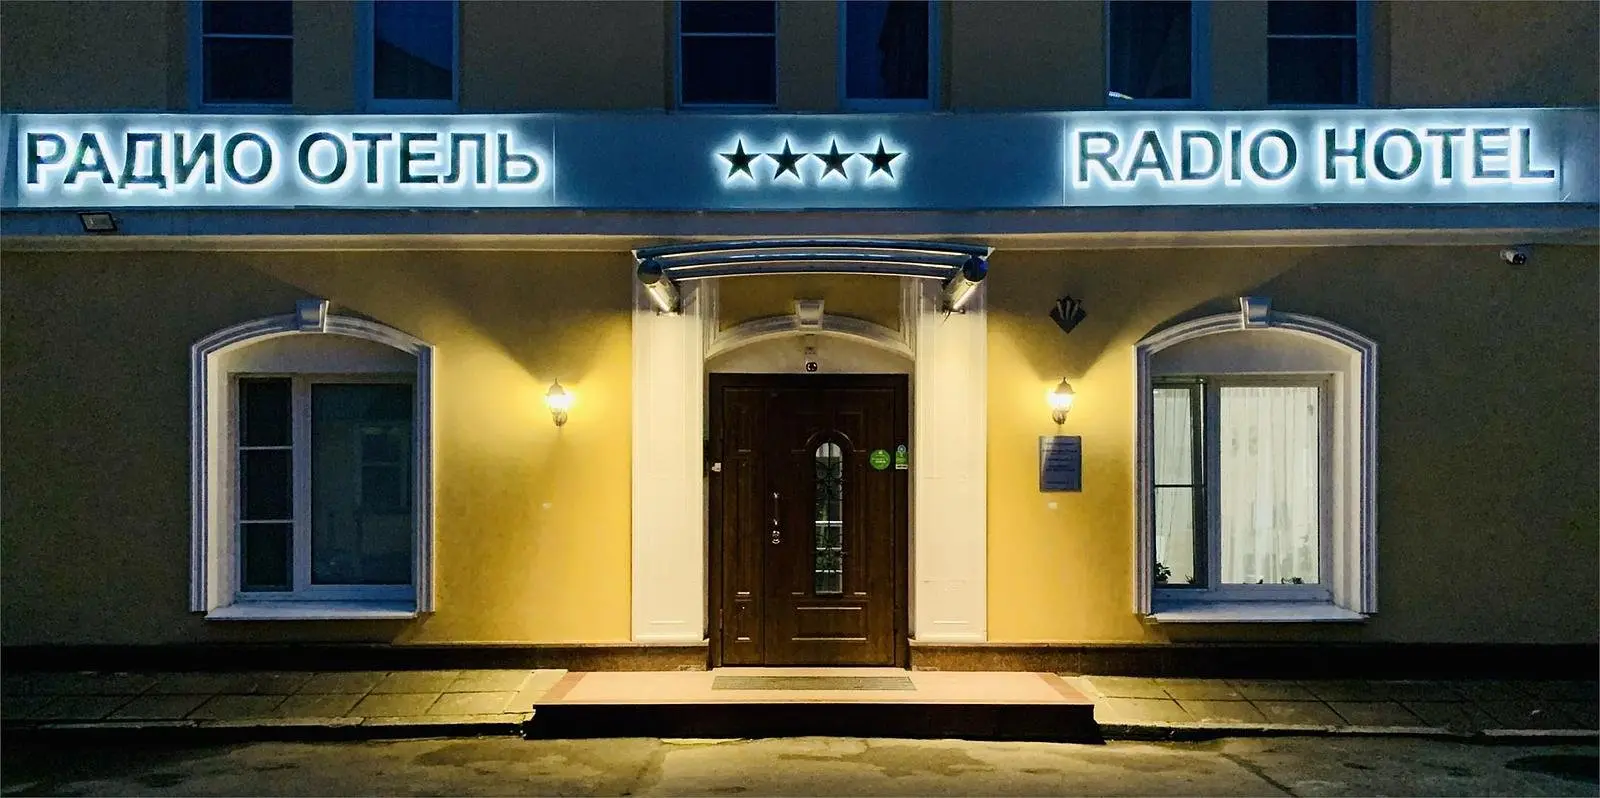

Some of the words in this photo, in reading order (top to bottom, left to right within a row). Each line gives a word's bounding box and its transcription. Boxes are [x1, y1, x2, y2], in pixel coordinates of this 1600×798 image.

[27, 132, 273, 189] РАДИО
[298, 132, 540, 184] ОТЕЛЬ
[1077, 128, 1298, 182] RADIO
[1324, 127, 1555, 180] HOTEL
